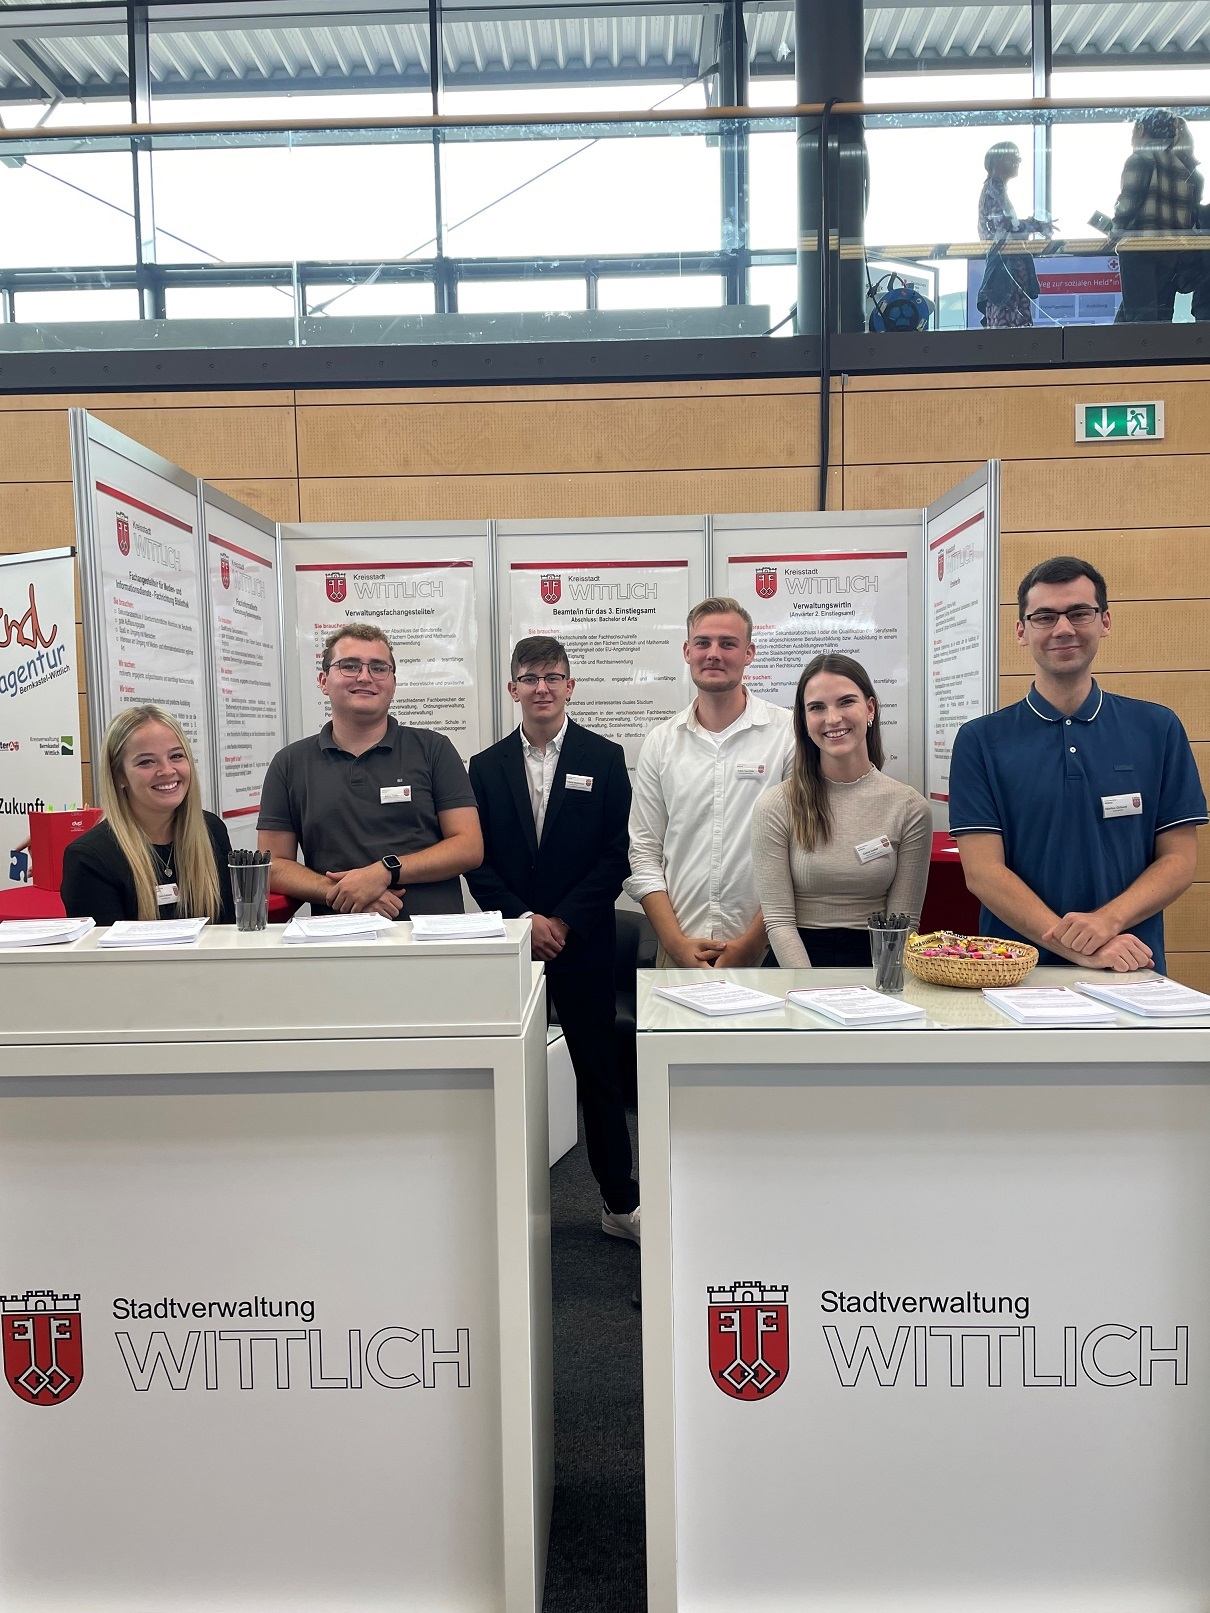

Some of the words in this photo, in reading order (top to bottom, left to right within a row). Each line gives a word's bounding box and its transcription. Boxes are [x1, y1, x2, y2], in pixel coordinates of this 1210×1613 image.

[354, 581, 444, 599] WITTLICH
[569, 583, 657, 600] WITTLICH
[785, 575, 879, 594] WITTLICH
[345, 608, 435, 617] Verwaltungsfachangestellte/r
[615, 607, 656, 616] Einstiegsamt
[20, 664, 70, 694] Bernkastel-Wittlich
[0, 798, 44, 815] Zukunft
[112, 1296, 315, 1322] Stadtverwaltung
[820, 1290, 1030, 1318] Stadtverwaltung
[114, 1326, 470, 1391] WITTLICH
[822, 1323, 1188, 1387] WITTLICH
